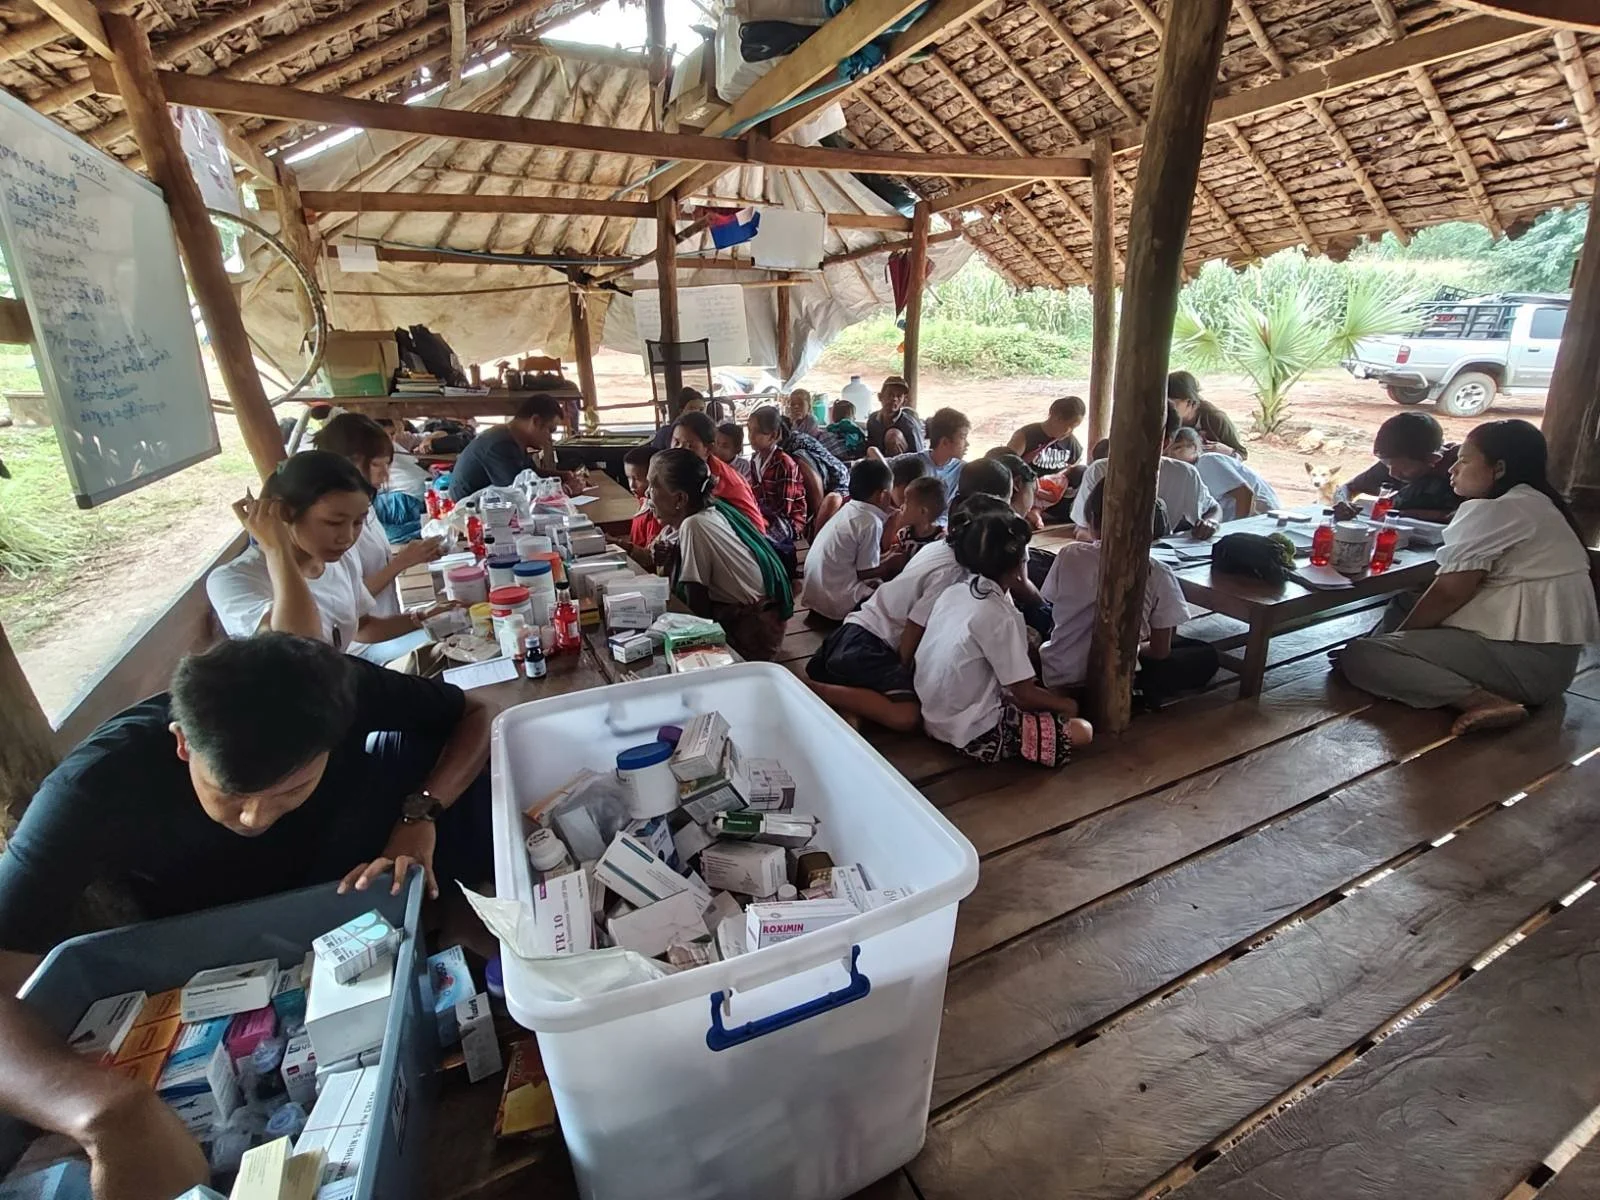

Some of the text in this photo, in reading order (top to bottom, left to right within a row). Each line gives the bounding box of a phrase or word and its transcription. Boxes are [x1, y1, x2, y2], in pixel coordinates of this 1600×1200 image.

[553, 914, 564, 929] 10
[762, 923, 804, 934] ROXIMIN
[335, 1138, 359, 1180] ERMETHRIN
